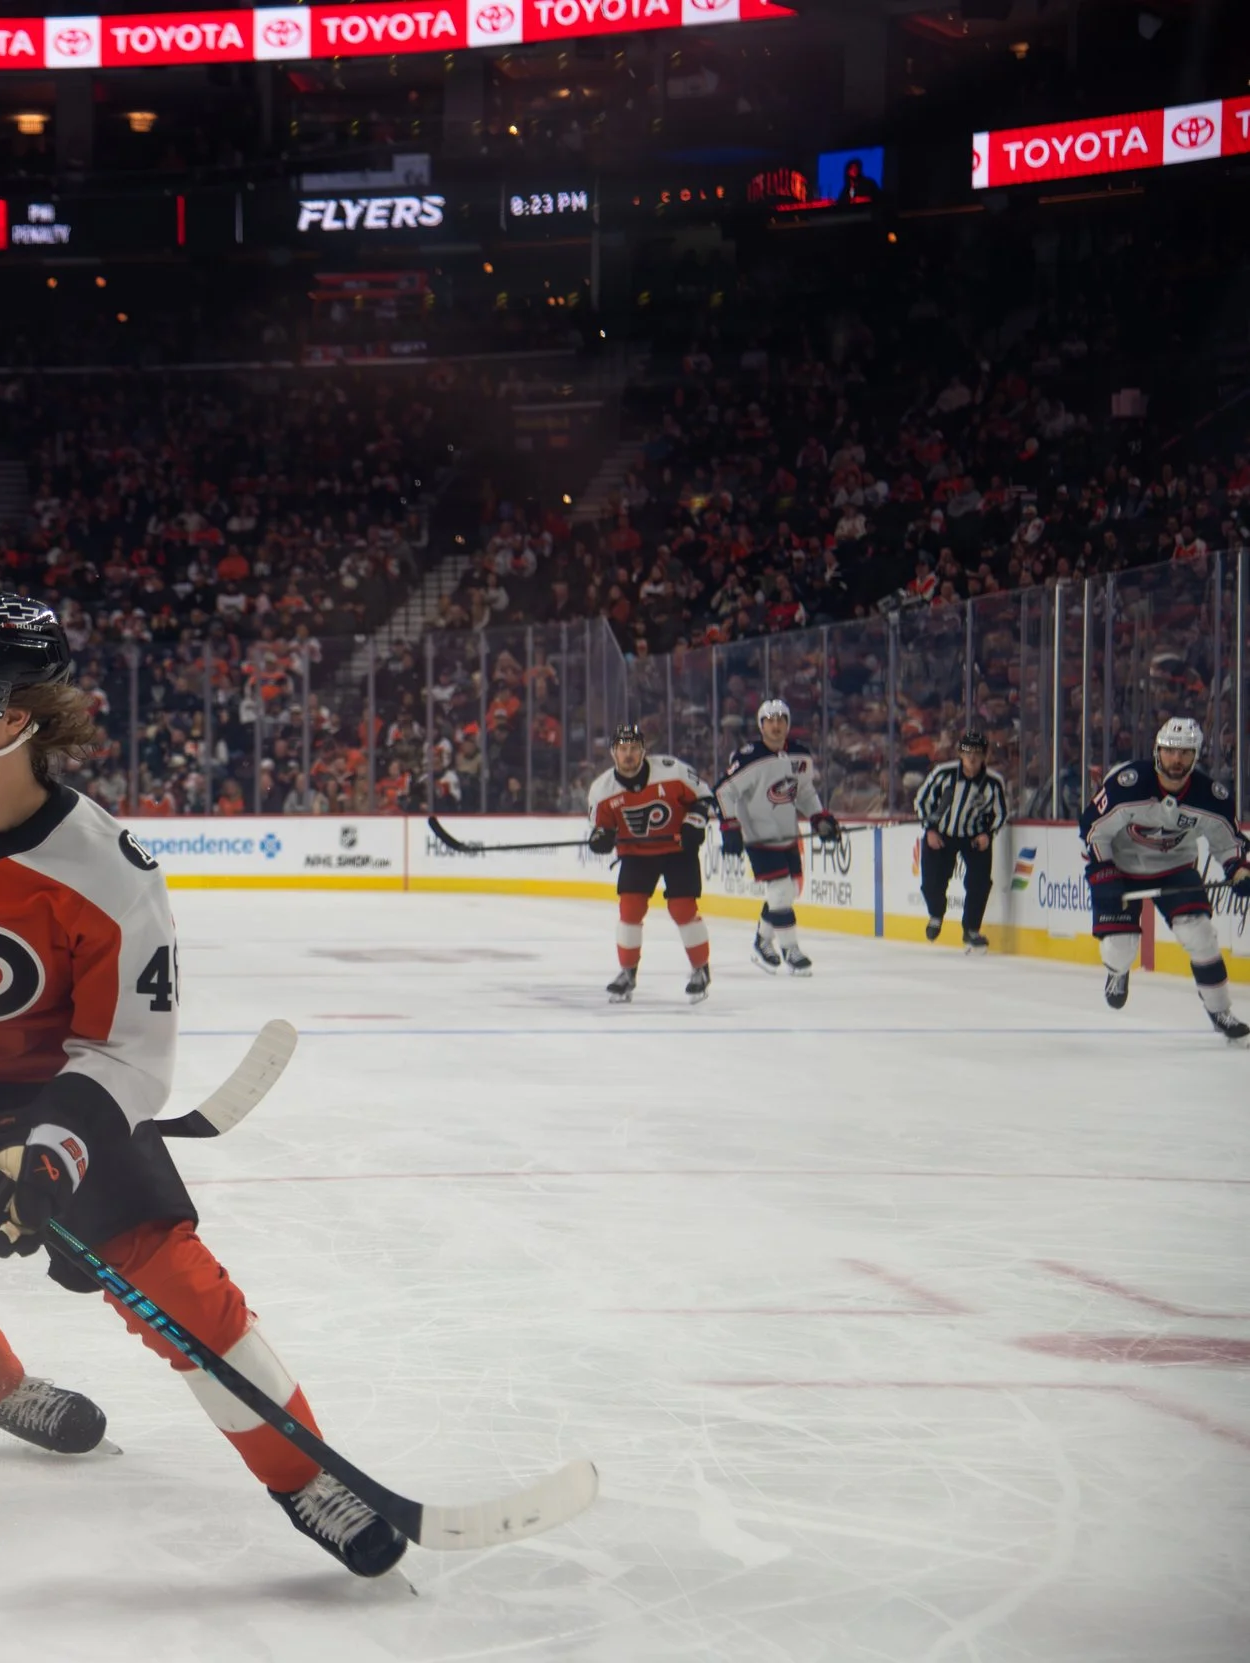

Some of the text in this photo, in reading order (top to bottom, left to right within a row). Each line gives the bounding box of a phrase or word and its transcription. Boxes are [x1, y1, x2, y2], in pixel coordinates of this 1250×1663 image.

[111, 23, 244, 54] TOYOTA
[321, 10, 457, 44] TOYOTA
[1002, 127, 1149, 171] TOYOTA
[297, 195, 446, 232] FLYERS
[557, 190, 588, 213] PM
[136, 831, 255, 858] ependence
[810, 879, 853, 906] PARTNER
[136, 937, 179, 1012] 4
